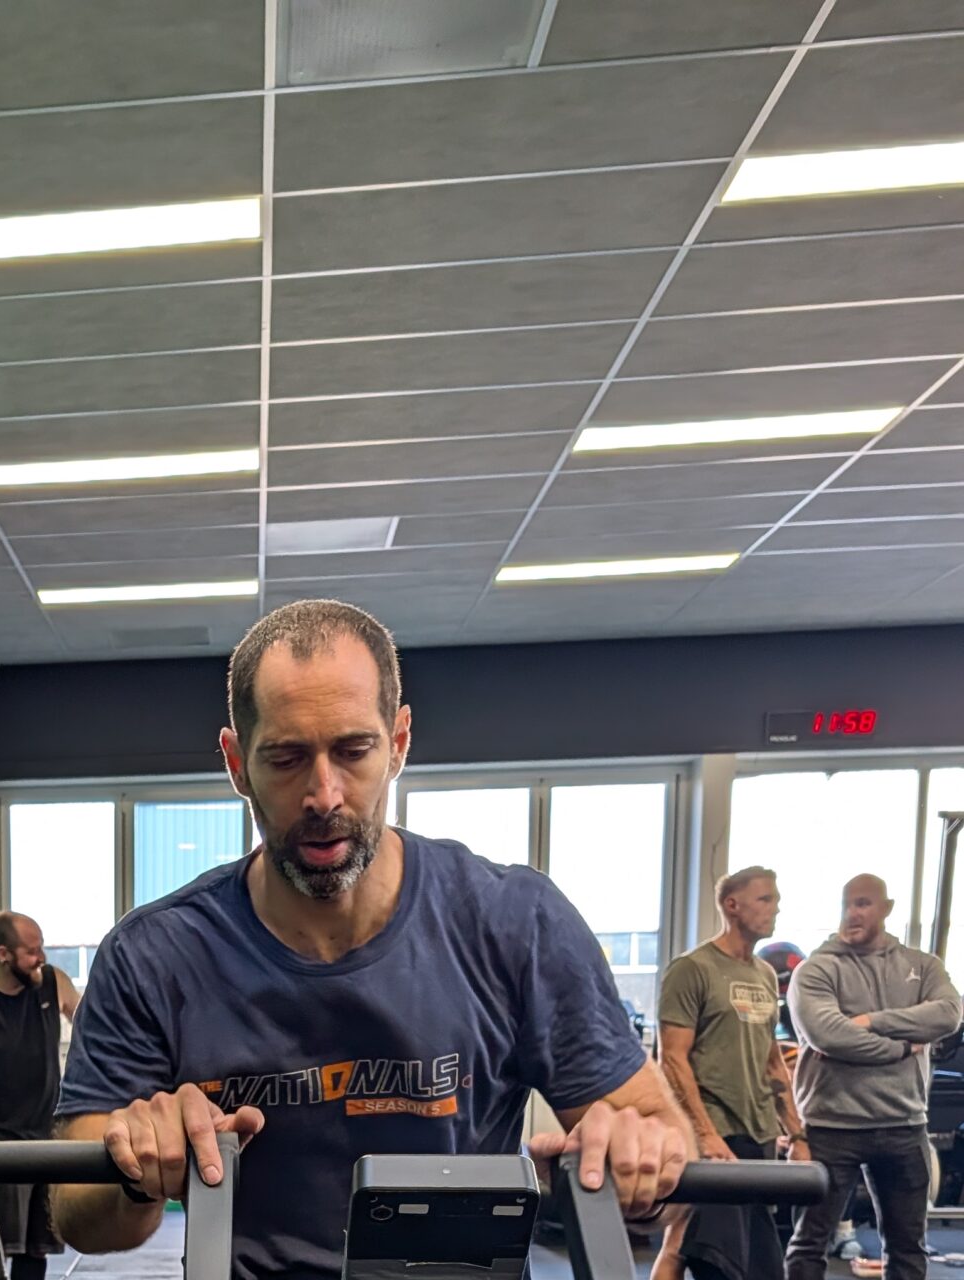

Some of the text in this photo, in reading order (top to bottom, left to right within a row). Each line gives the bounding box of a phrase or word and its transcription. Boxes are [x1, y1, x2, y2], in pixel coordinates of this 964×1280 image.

[219, 1053, 459, 1109] NATIONALS
[364, 1100, 441, 1116] SEASON 5
